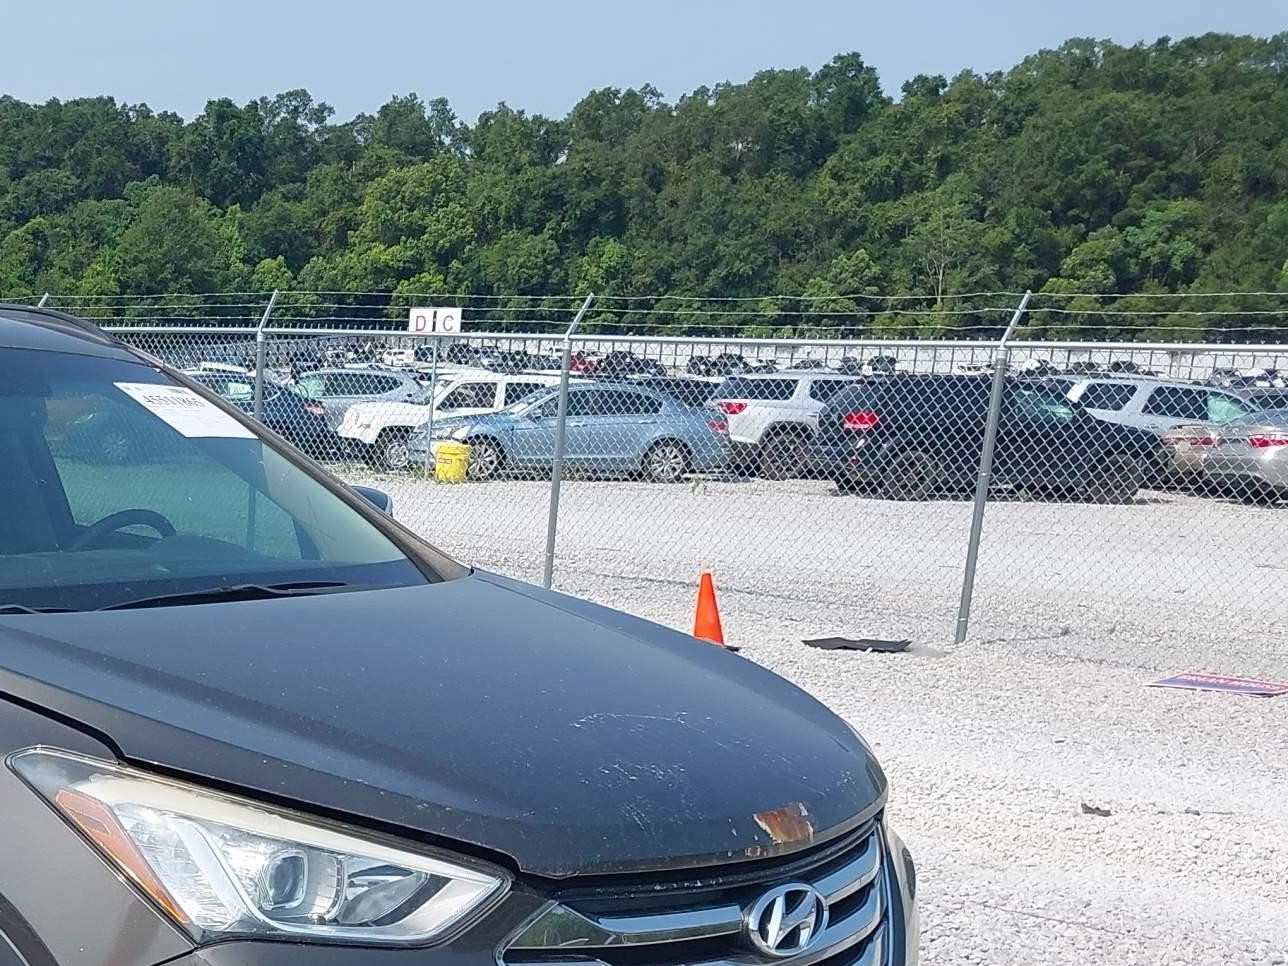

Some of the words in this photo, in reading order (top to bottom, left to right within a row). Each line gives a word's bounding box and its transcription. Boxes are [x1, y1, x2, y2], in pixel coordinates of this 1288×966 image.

[415, 315, 427, 332] D
[443, 314, 454, 332] C
[142, 394, 206, 409] 45511865
